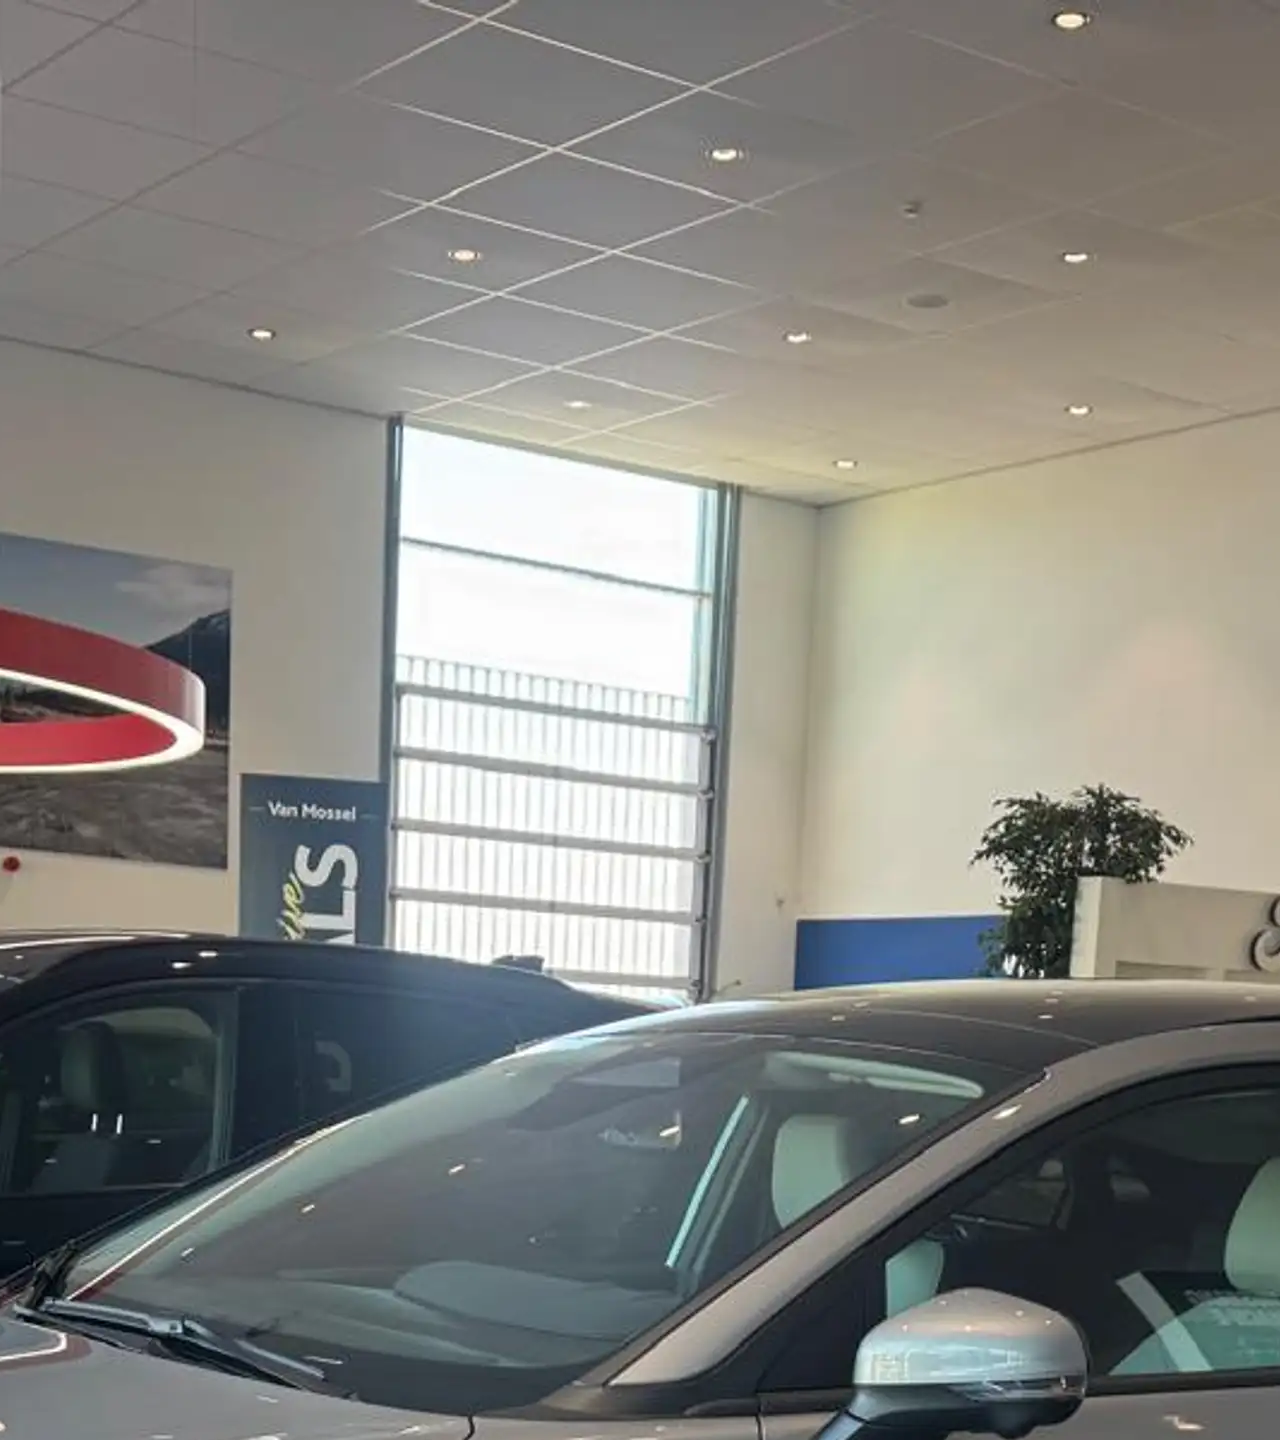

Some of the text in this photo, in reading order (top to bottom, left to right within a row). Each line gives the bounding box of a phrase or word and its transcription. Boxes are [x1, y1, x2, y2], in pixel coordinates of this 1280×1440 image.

[267, 800, 357, 822] Van Mossel
[295, 844, 358, 944] LS
